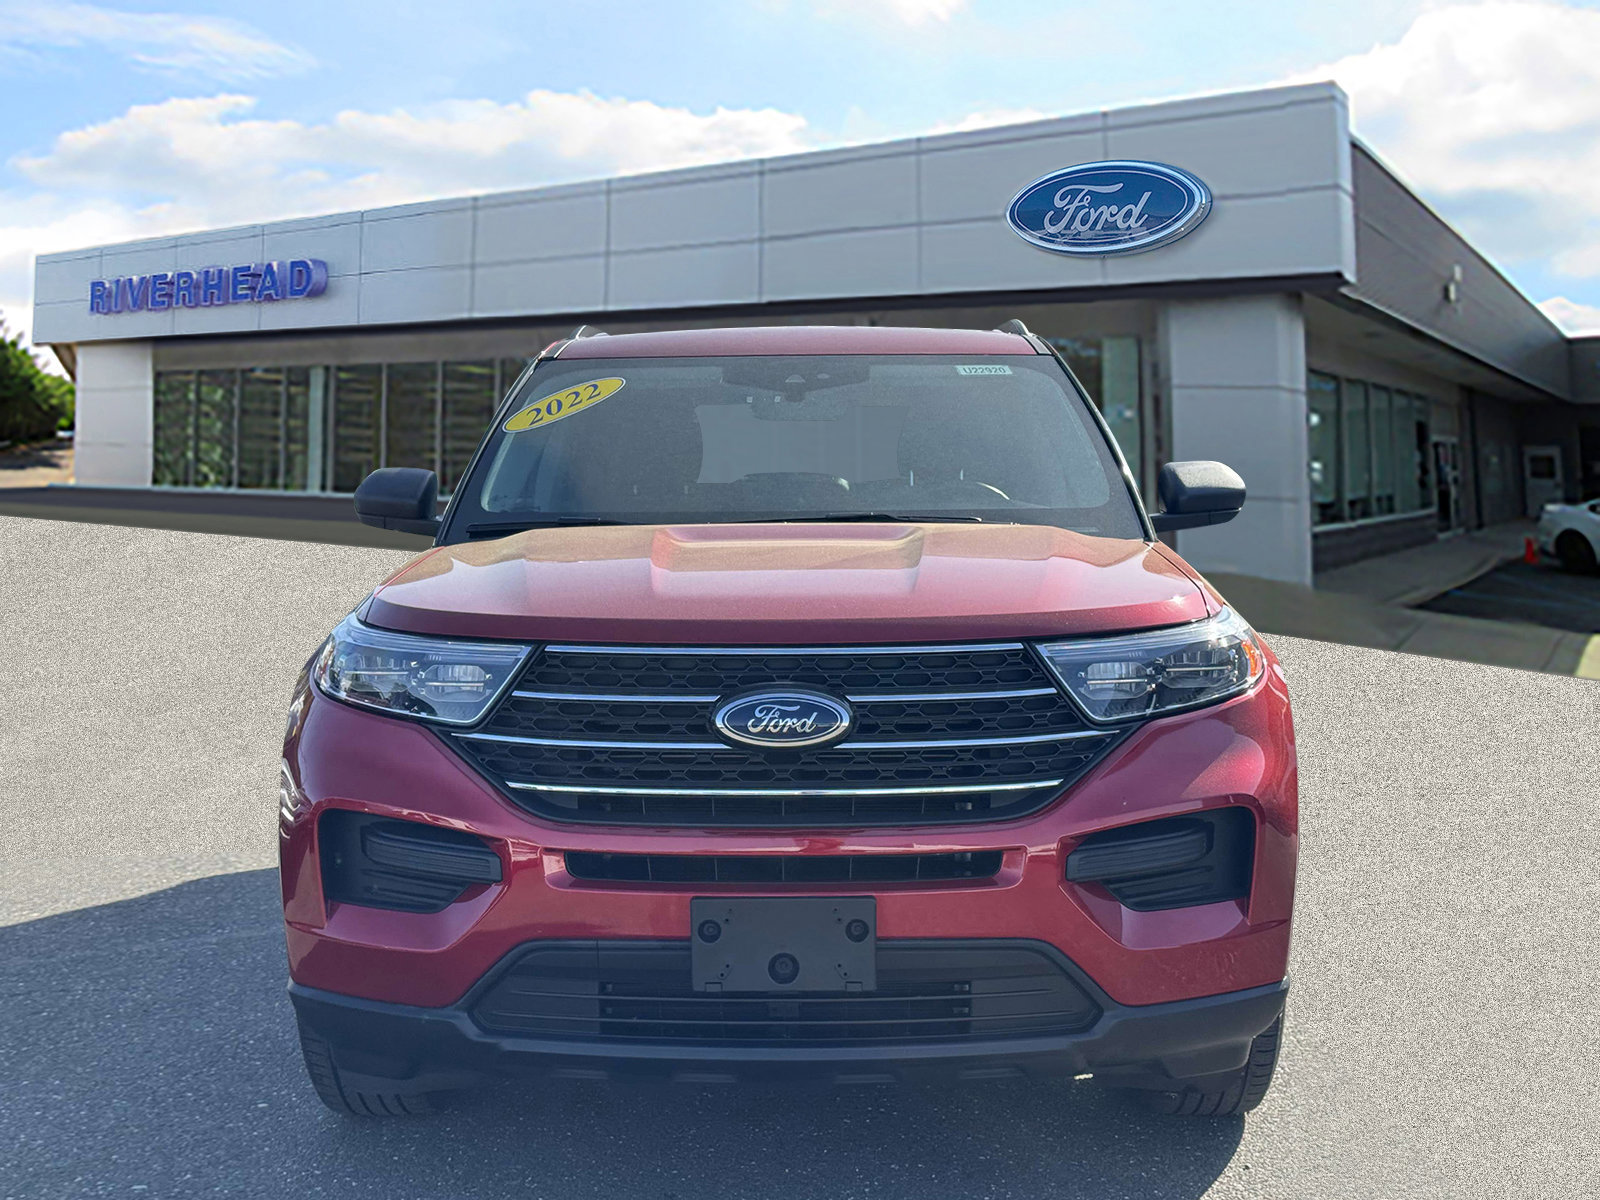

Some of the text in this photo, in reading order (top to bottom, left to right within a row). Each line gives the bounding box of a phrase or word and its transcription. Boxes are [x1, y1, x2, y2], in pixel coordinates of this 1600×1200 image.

[1043, 182, 1152, 234] Ford
[90, 259, 326, 314] RIVERHEAD
[526, 383, 602, 426] 2022
[747, 704, 818, 733] Ford
